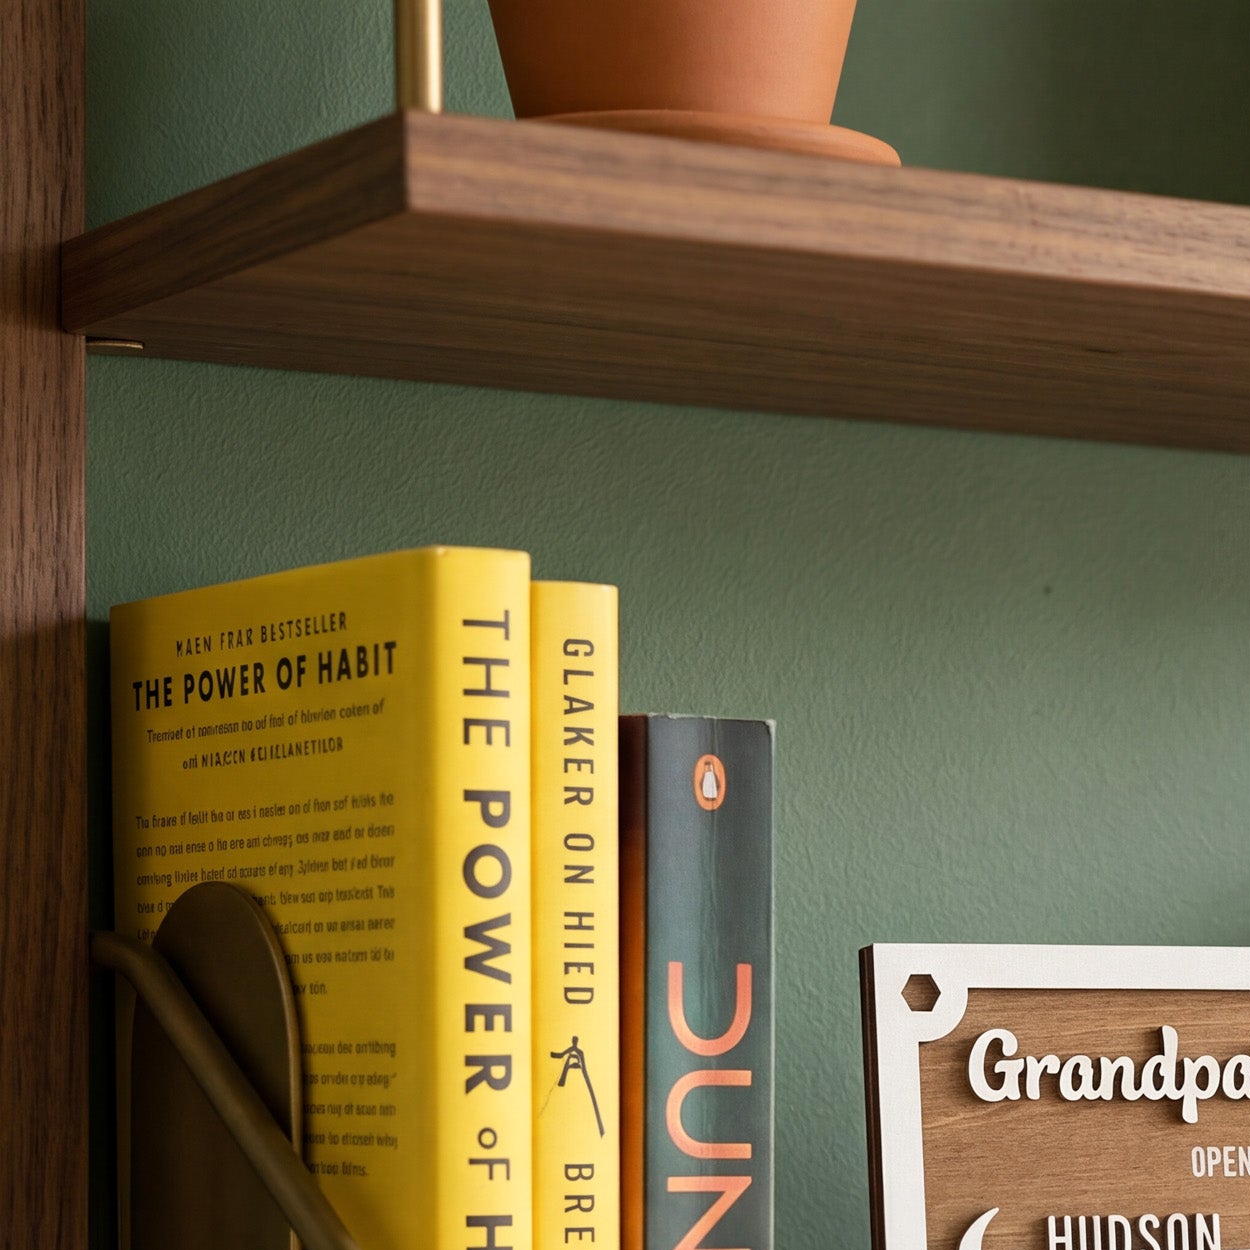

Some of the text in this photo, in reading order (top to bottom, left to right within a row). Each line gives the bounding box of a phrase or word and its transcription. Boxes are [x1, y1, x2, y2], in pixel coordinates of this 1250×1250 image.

[132, 640, 397, 712] THE POWER OF HABIT
[260, 611, 348, 644] BESTSELLER
[462, 609, 511, 748] THE
[562, 638, 595, 1005] GLAKER ON HIED
[462, 788, 513, 1095] POWER
